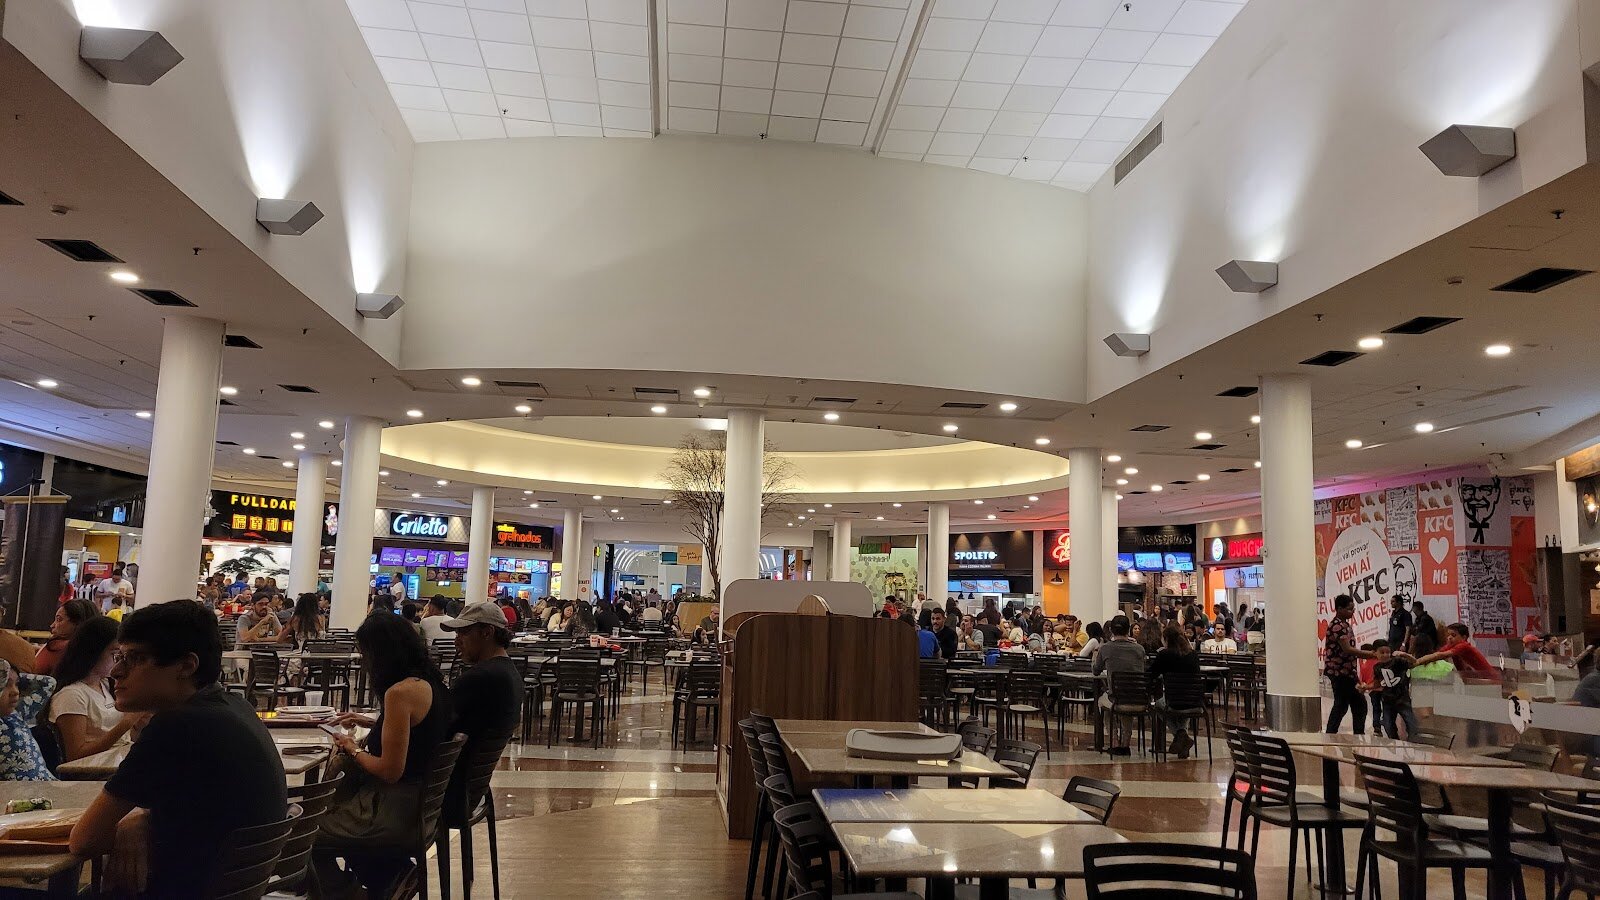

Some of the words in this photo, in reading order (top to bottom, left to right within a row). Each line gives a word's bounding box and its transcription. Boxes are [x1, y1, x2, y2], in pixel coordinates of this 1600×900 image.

[1335, 497, 1356, 512] KFC
[393, 514, 448, 536] Griletto
[1335, 513, 1358, 528] KFC
[1423, 515, 1453, 533] KFC
[954, 551, 997, 560] SPOLETO
[1336, 562, 1358, 584] VEM
[1360, 552, 1371, 573] AÍ
[1432, 569, 1448, 585] MG
[1348, 568, 1390, 604] KFC
[1360, 597, 1391, 623] VOCÊ.
